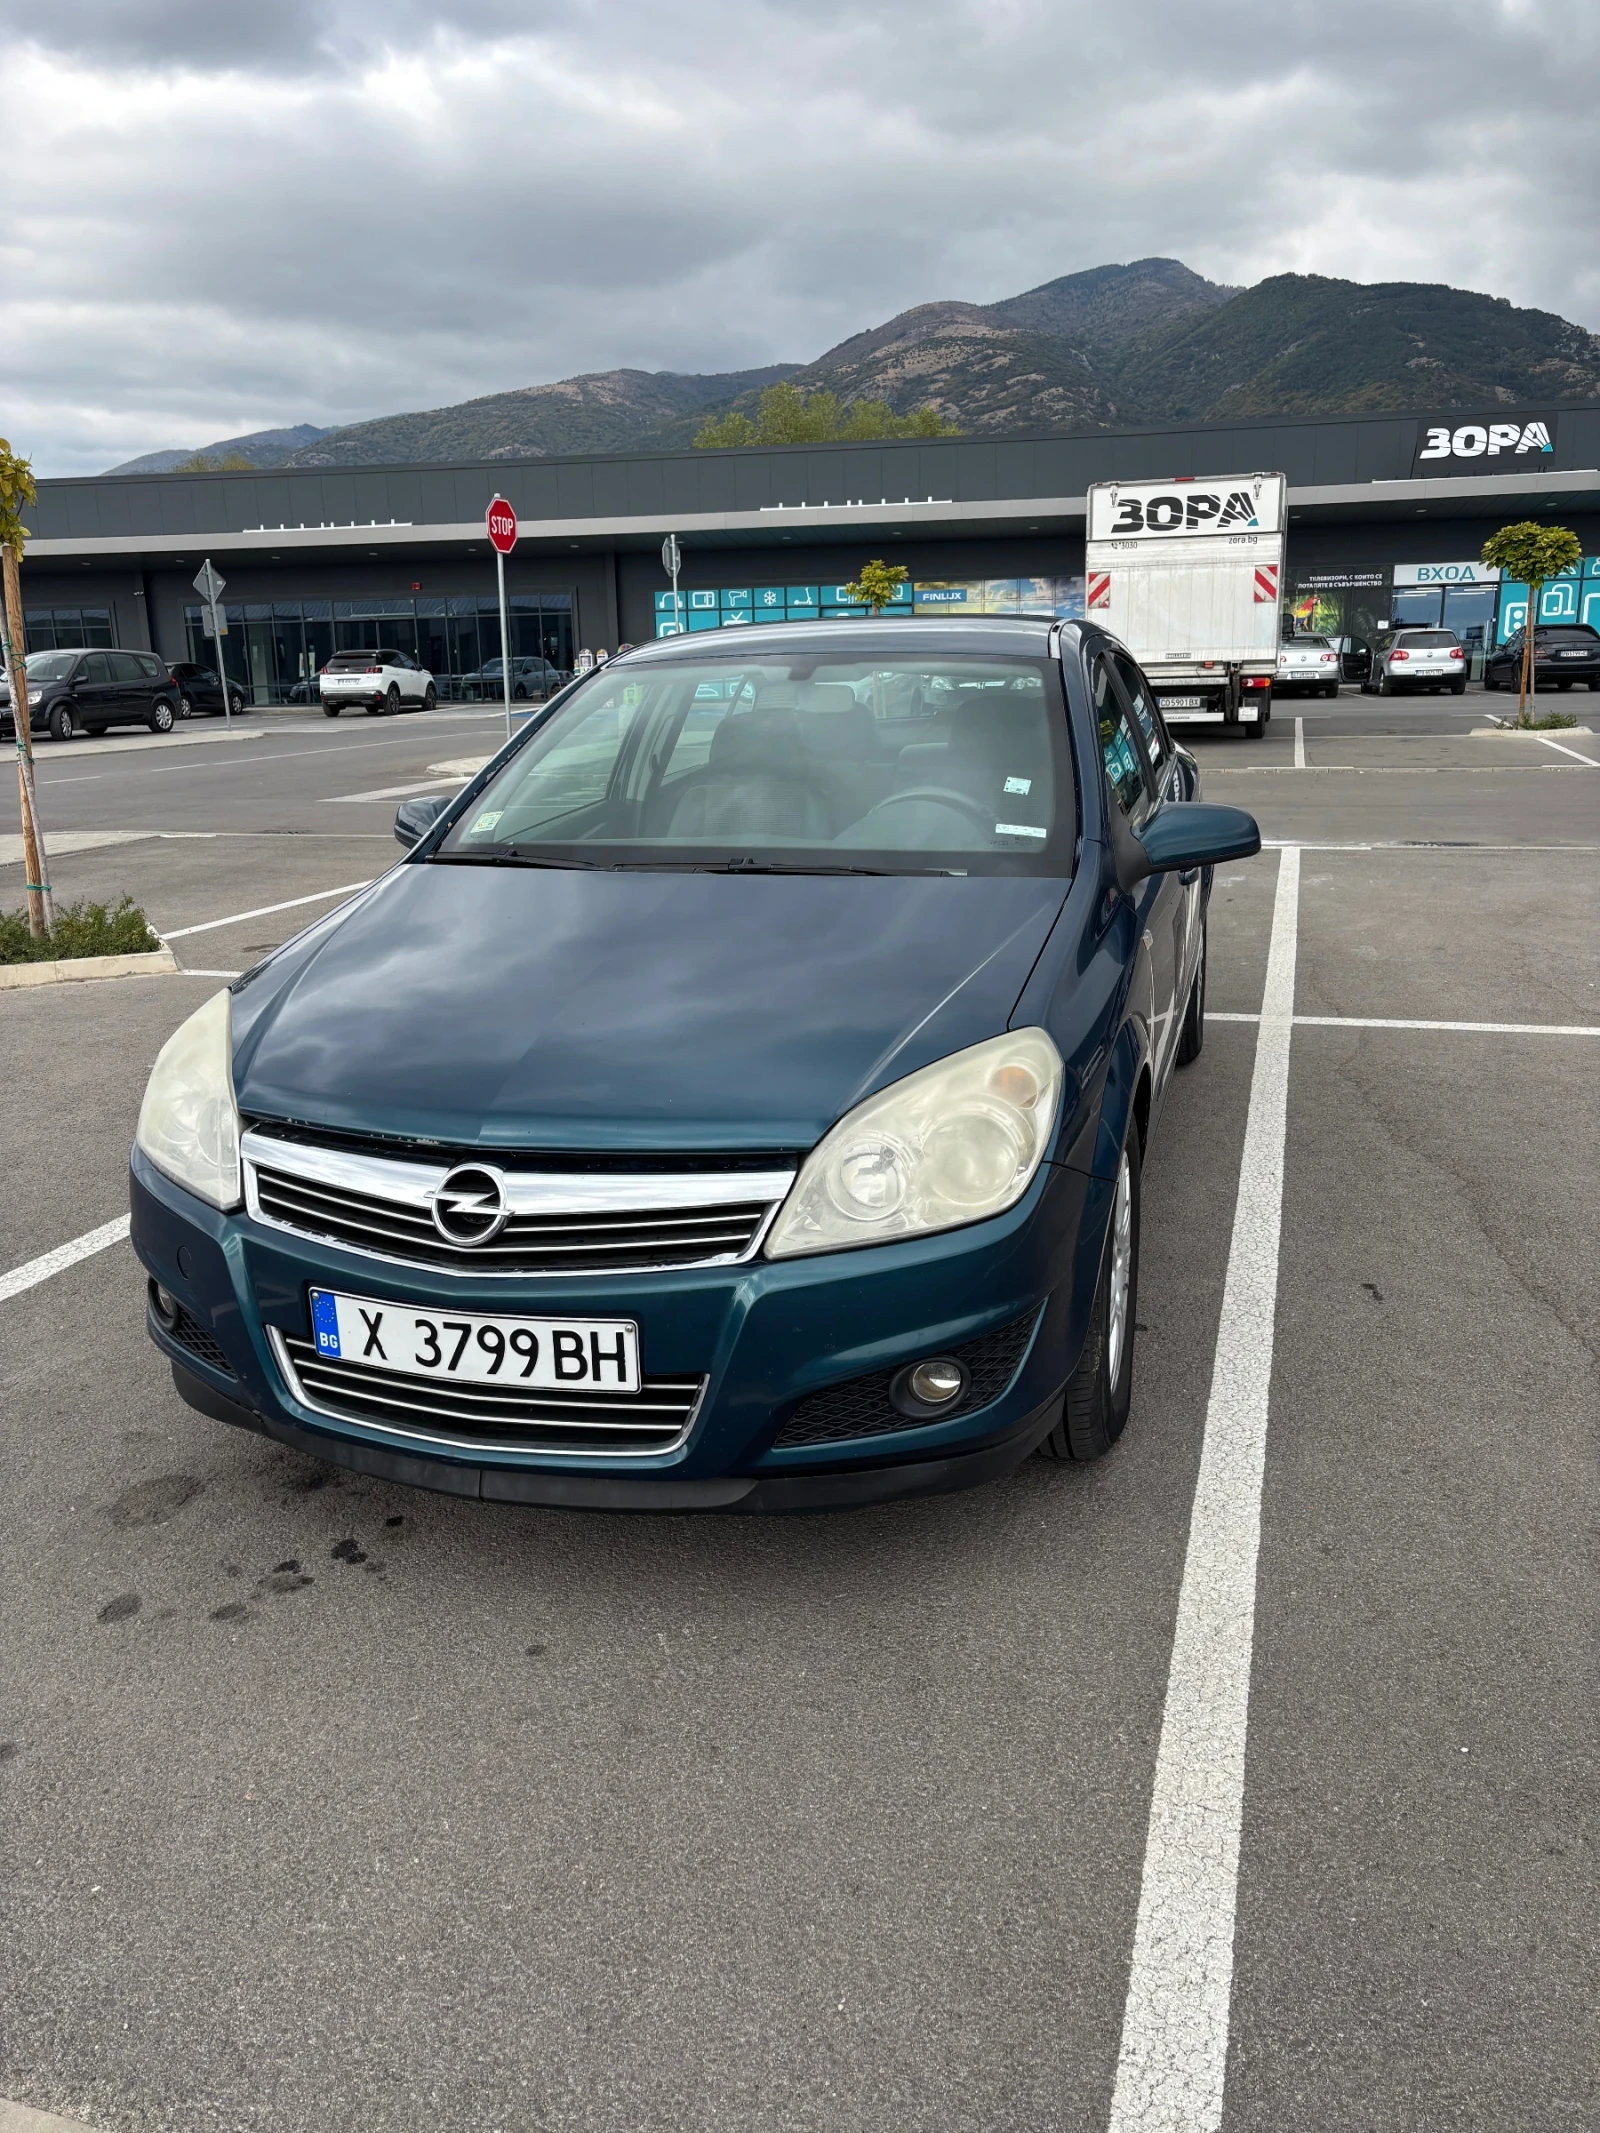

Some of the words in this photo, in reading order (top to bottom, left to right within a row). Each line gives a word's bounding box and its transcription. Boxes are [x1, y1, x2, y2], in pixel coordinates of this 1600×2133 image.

[1419, 422, 1553, 459] ЗОРА
[1111, 492, 1259, 533] ЗОРА
[491, 515, 513, 536] STOP
[1228, 536, 1258, 545] zora.bg
[1417, 566, 1476, 581] ВХОД
[922, 592, 962, 600] FINLUX
[320, 1333, 338, 1350] BG
[358, 1308, 389, 1360] X
